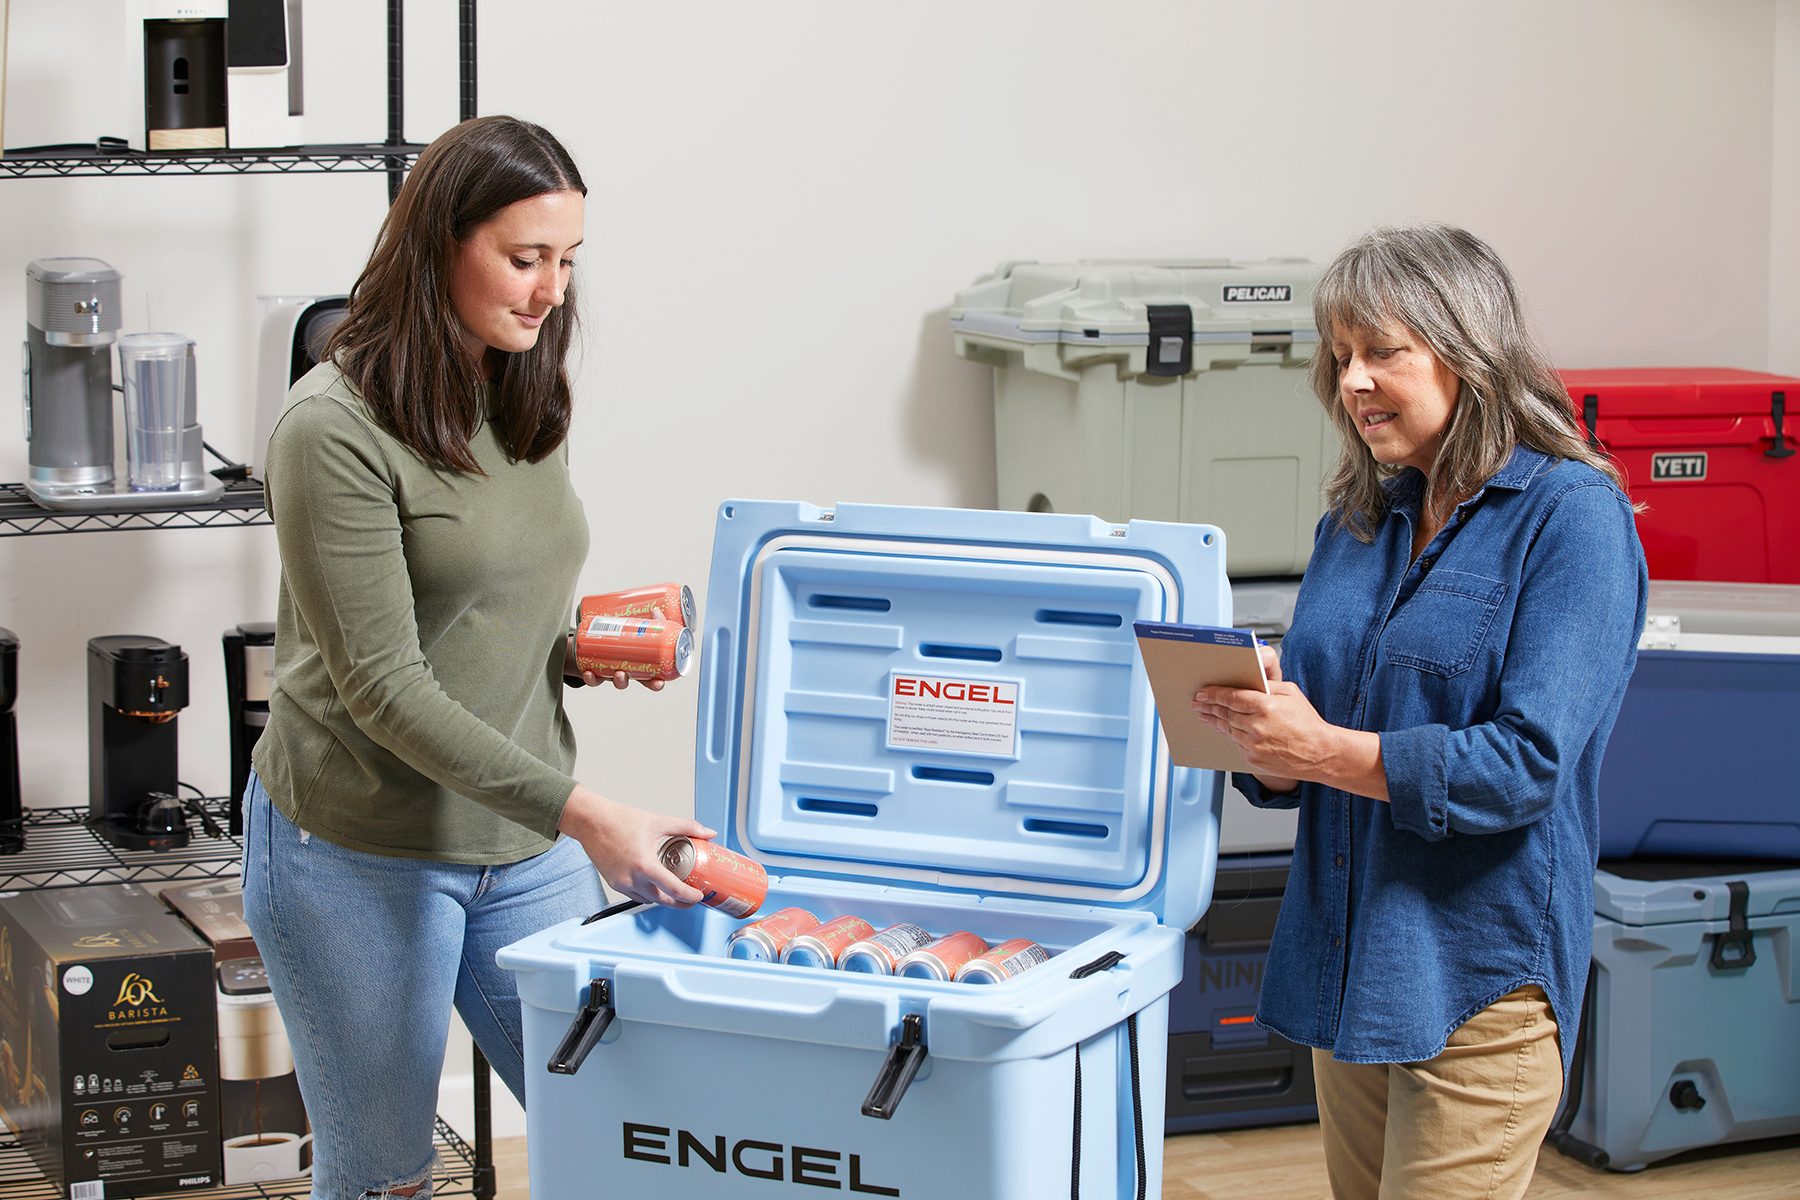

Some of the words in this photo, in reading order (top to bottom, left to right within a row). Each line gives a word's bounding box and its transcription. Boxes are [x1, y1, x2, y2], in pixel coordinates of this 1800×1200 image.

[1227, 287, 1287, 300] PELICAN
[1656, 458, 1702, 476] YETI
[895, 678, 1014, 704] ENGEL
[65, 976, 92, 984] WHITE
[1200, 959, 1263, 995] NINJ
[108, 1007, 168, 1021] BARISTA
[623, 1121, 900, 1197] ENGEL
[179, 1176, 211, 1186] PHILIPS
